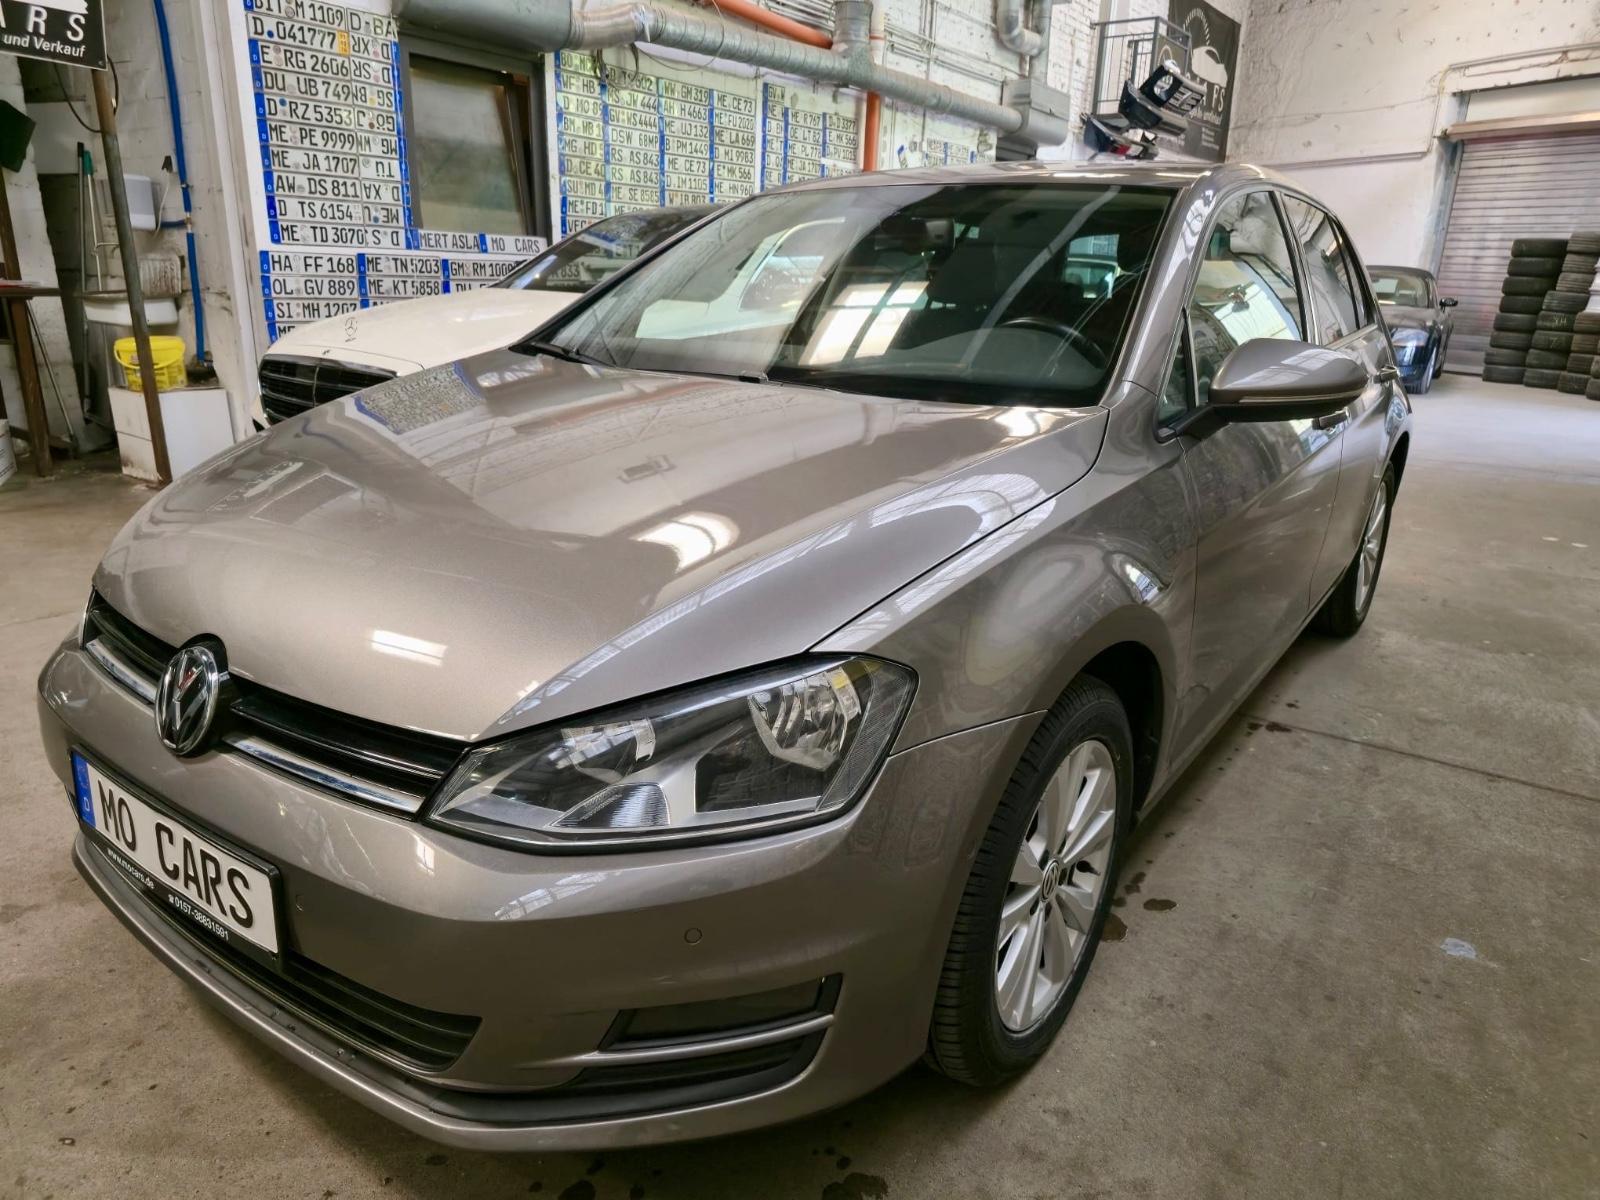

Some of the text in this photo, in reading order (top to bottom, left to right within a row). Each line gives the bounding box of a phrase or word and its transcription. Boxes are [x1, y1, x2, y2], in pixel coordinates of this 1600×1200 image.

[295, 0, 306, 19] M
[309, 3, 343, 27] 1109
[252, 17, 264, 36] D
[276, 21, 336, 50] 041777
[3, 34, 86, 57] und Verkauf
[261, 45, 350, 77] E RG 2606
[263, 71, 351, 102] DU UB 749
[582, 79, 595, 94] HB
[693, 88, 708, 103] 319
[266, 98, 353, 126] D RZ 5353
[641, 96, 656, 112] 444
[680, 104, 686, 116] H
[687, 106, 707, 121] 4663
[717, 94, 752, 113] ME CE 73
[639, 116, 657, 129] 4444
[694, 125, 708, 138] 132
[269, 124, 355, 150] ME PE 9999
[730, 132, 740, 144] LA
[272, 150, 358, 175] ME JA 1707
[611, 148, 623, 161] RS
[630, 151, 641, 164] AS
[643, 153, 659, 167] 843
[668, 157, 706, 173] ME CE 73
[579, 161, 592, 175] CE
[612, 167, 659, 185] RS AS 843
[276, 175, 360, 198] AW DS 811
[278, 199, 287, 216] D
[298, 201, 316, 218] TS
[320, 203, 353, 221] 6154
[568, 200, 579, 213] ME
[280, 224, 365, 245] ME TD 3070
[420, 233, 479, 250] MERT ASLA
[491, 235, 540, 253] MO CARS
[271, 255, 355, 273] HA FF 168
[366, 257, 383, 272] ME
[392, 258, 408, 273] TN
[451, 263, 486, 277] GM RM
[273, 278, 355, 296] OL GV 889
[368, 280, 384, 295] ME
[393, 280, 408, 295] KT
[277, 302, 320, 318] SI MH
[98, 778, 137, 851] MO
[155, 822, 253, 928] CARS
